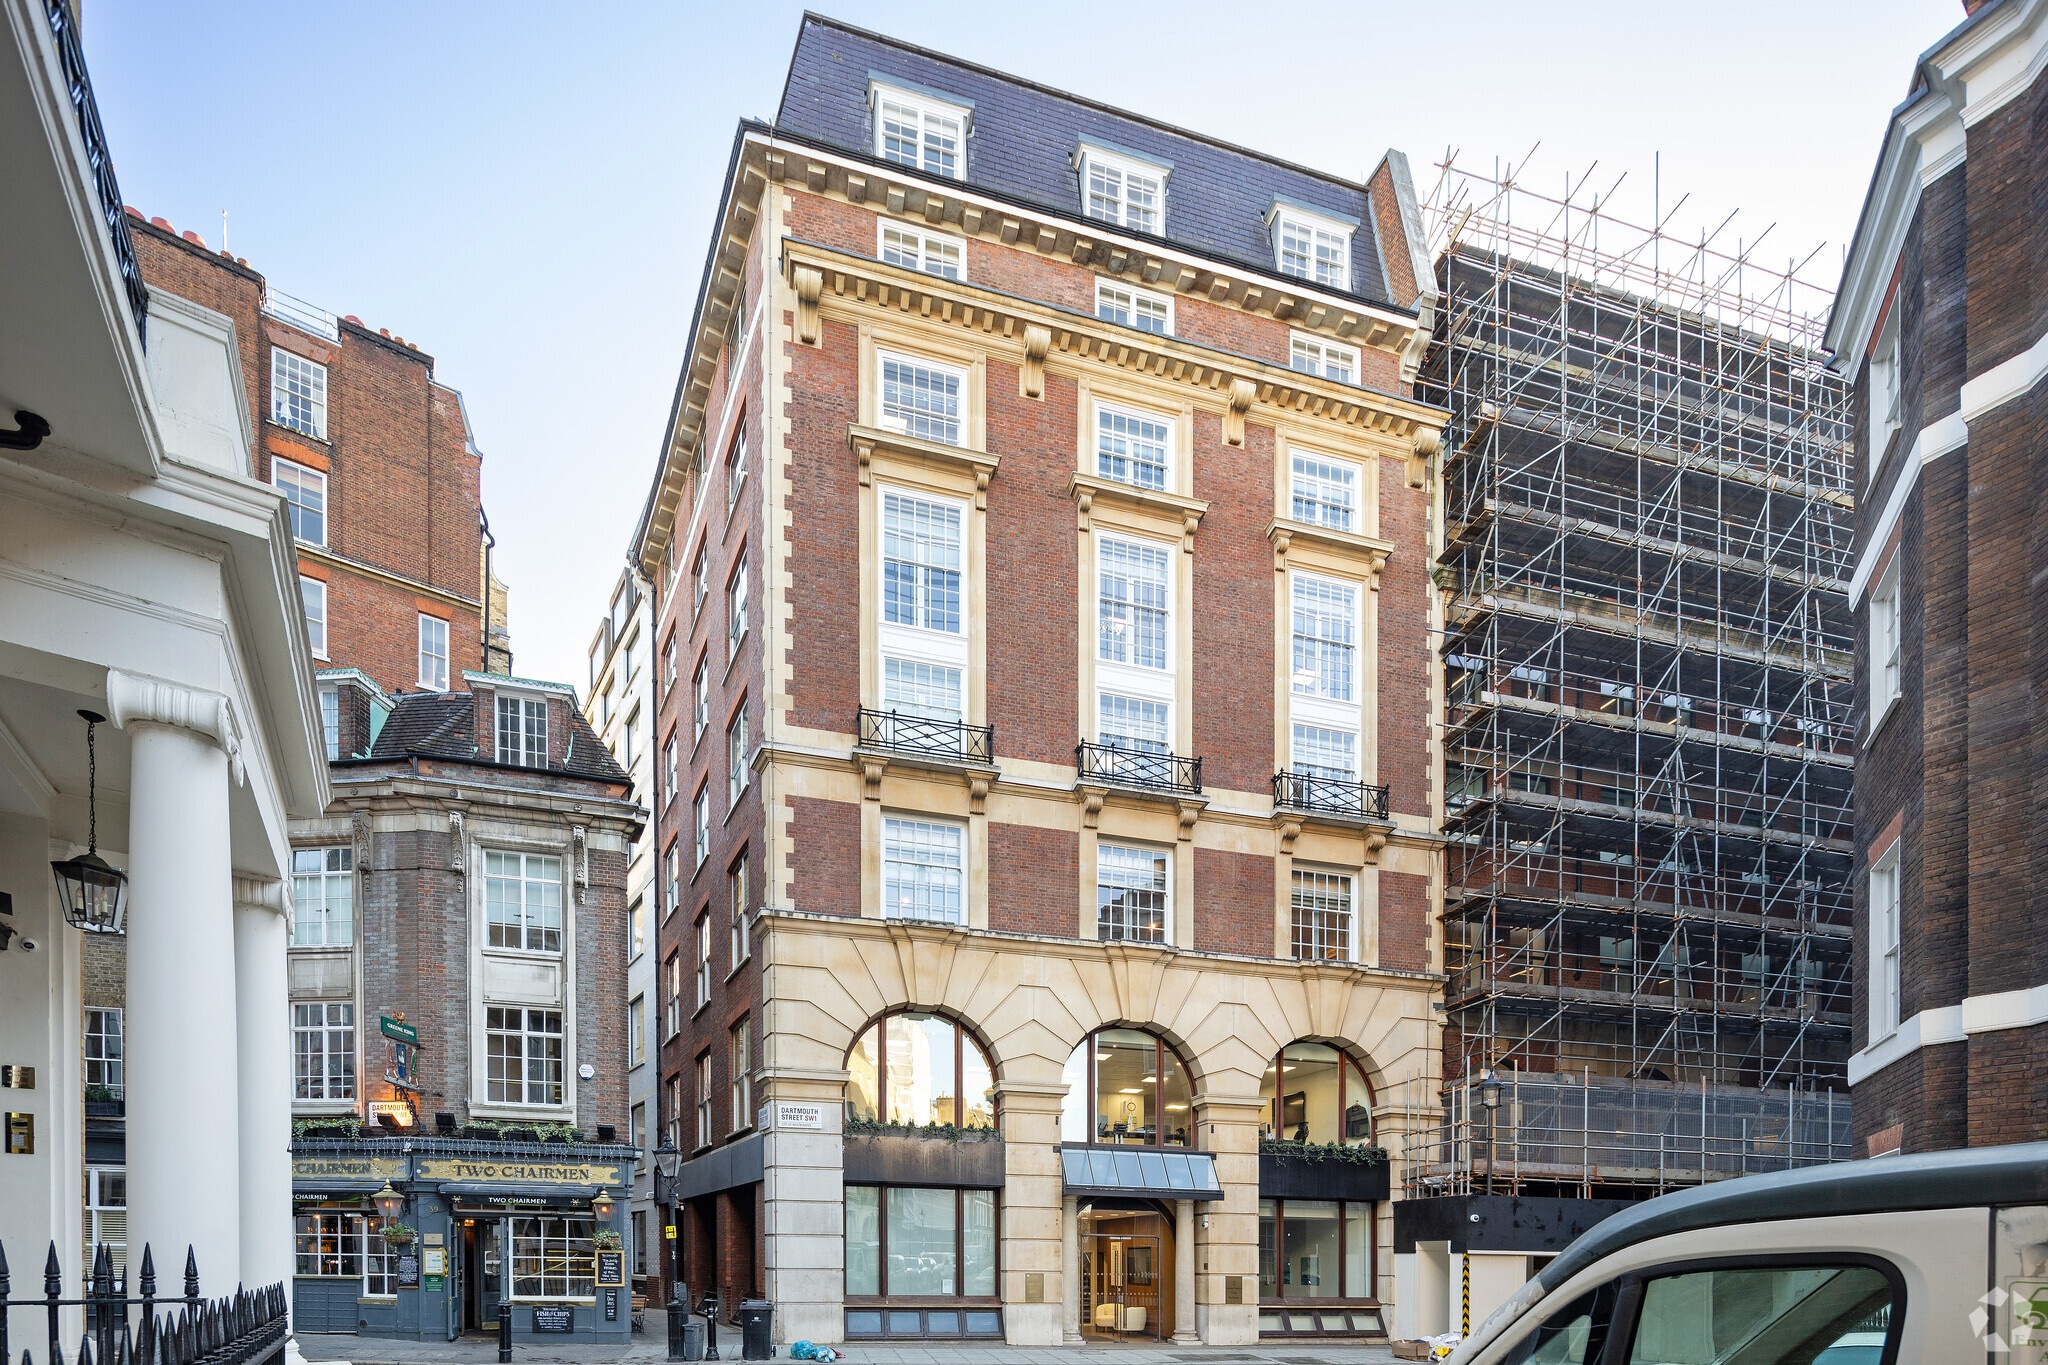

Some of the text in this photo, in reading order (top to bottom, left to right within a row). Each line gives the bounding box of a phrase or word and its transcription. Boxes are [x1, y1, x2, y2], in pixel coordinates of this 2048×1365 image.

[781, 1107, 819, 1115] DARTMOUTH
[295, 1163, 371, 1174] CHAIRMEN
[453, 1164, 590, 1180] TWO CHAIRMEN
